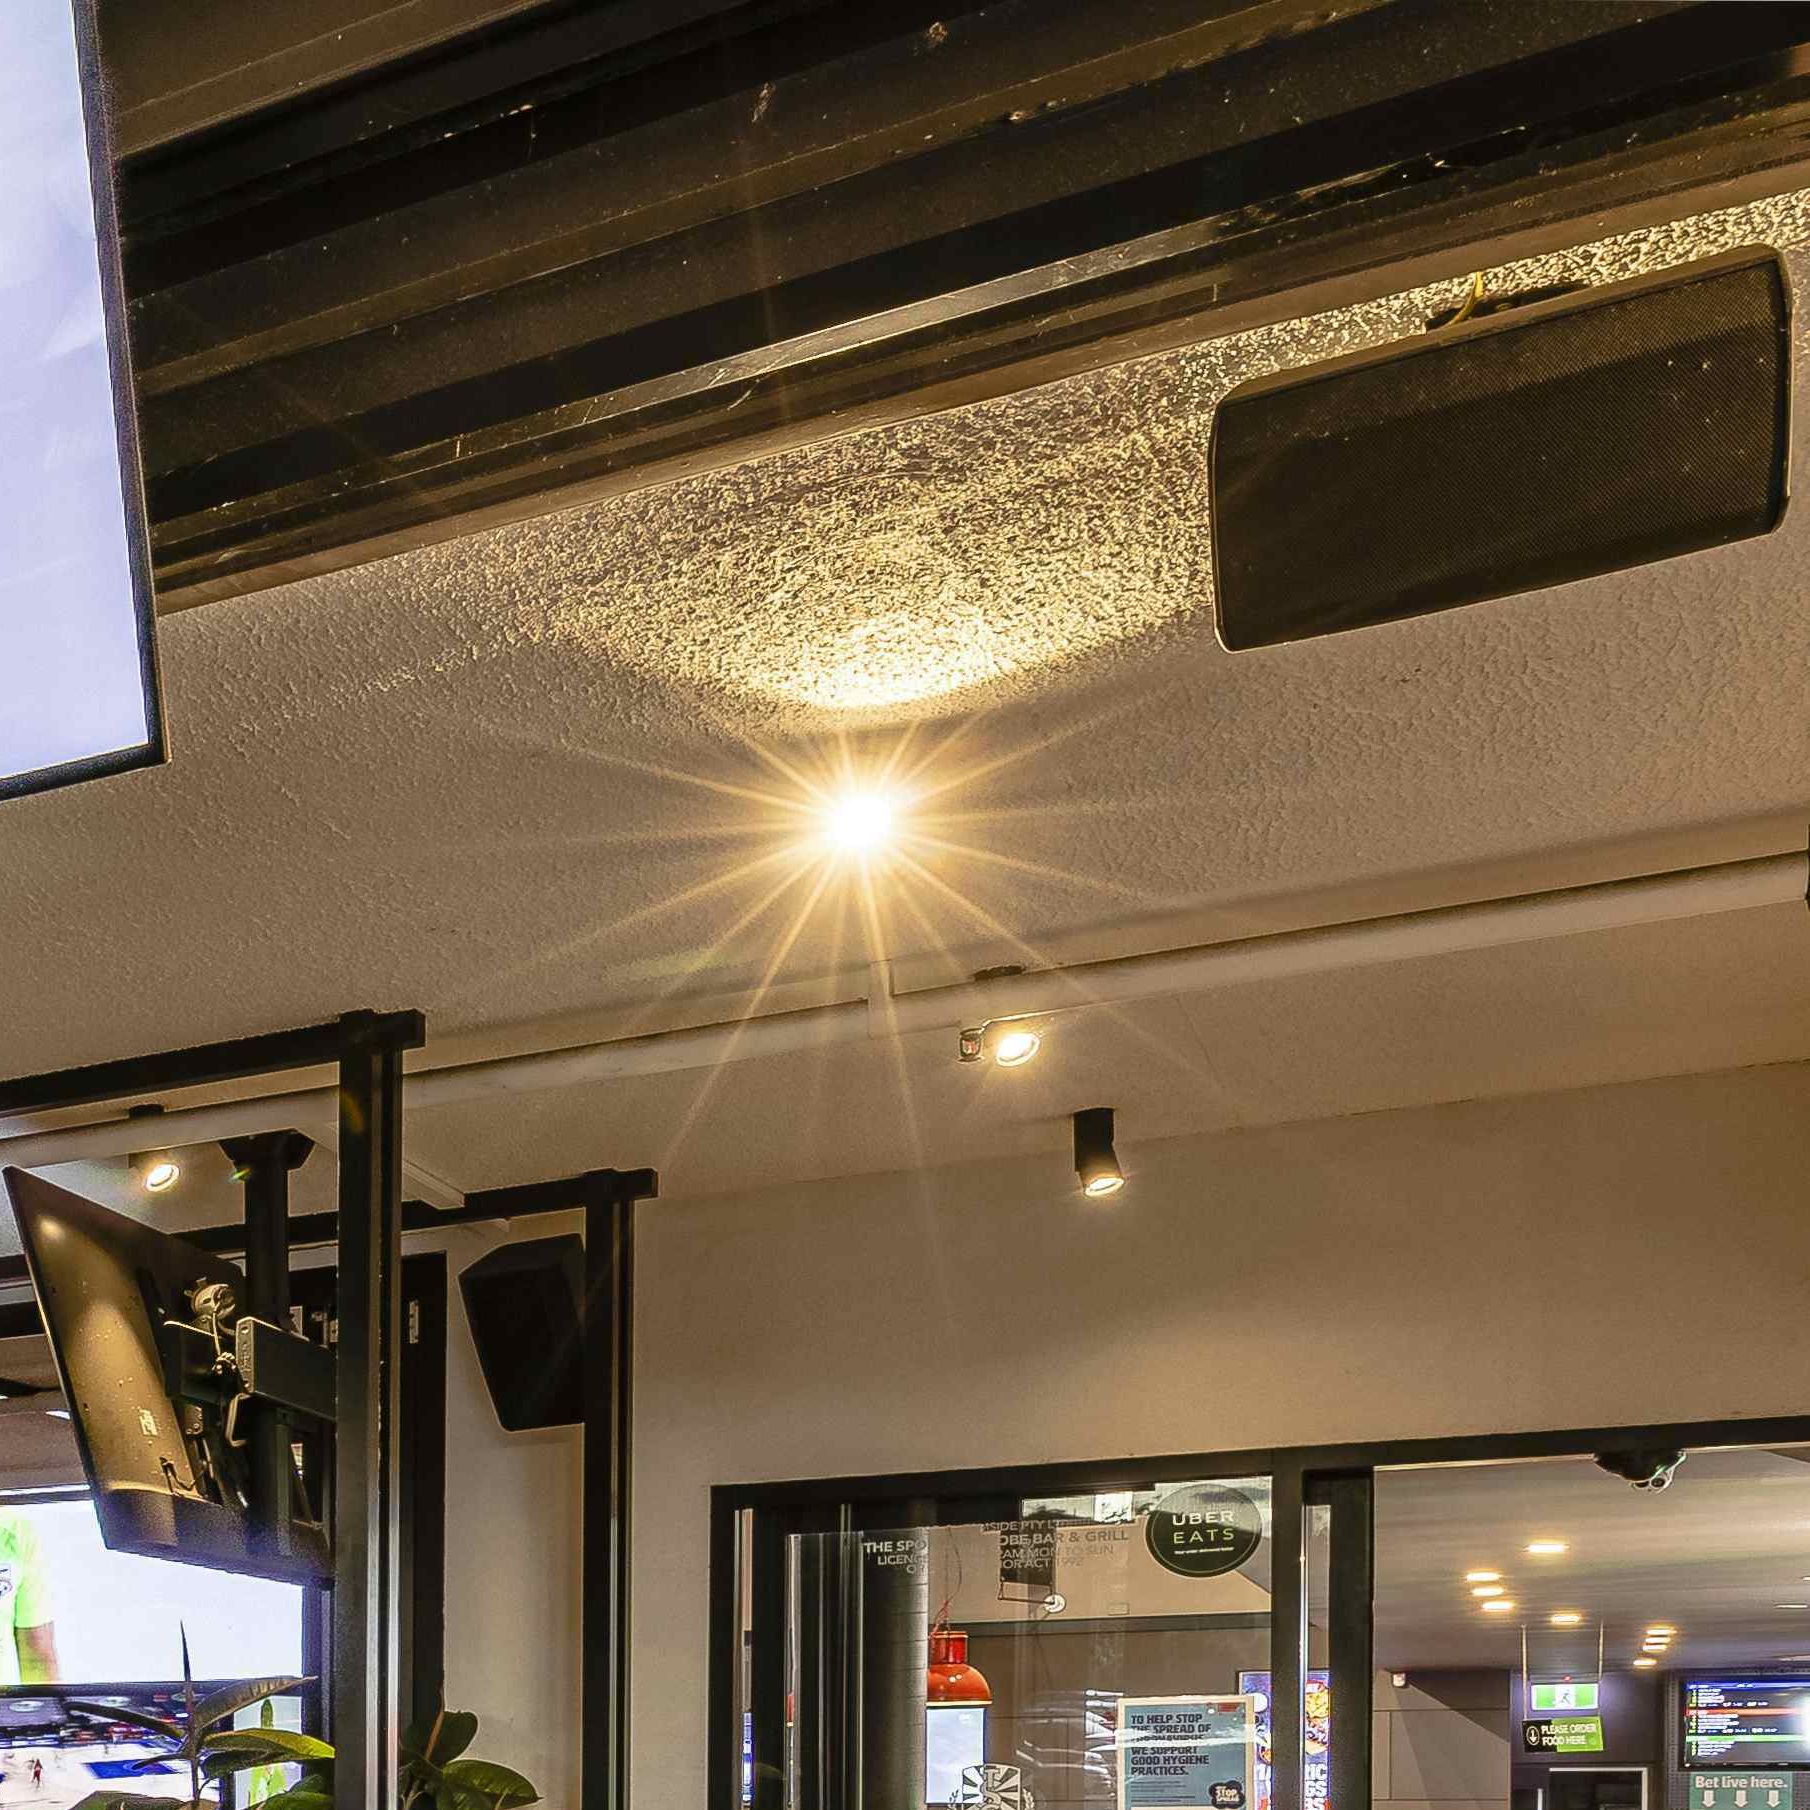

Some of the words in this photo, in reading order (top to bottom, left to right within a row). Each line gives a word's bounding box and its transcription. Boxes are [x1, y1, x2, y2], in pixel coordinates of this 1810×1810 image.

[1172, 1510, 1235, 1527] UBER
[1033, 1533, 1064, 1545] BAR
[1069, 1532, 1081, 1543] &
[1085, 1530, 1129, 1542] GRILL
[1172, 1527, 1236, 1545] EATS
[864, 1541, 893, 1553] THE
[1086, 1544, 1114, 1555] SUN
[1131, 1714, 1144, 1724] TO
[1146, 1714, 1173, 1724] HELP
[1176, 1713, 1203, 1724] STOP
[1154, 1724, 1195, 1734] SPREAD
[1198, 1724, 1211, 1733] OF
[1541, 1723, 1569, 1734] PLEASE
[1570, 1723, 1597, 1733] ORDER
[1542, 1735, 1565, 1746] FOOD
[1565, 1735, 1587, 1745] HERE
[1131, 1746, 1148, 1756] WE
[1150, 1746, 1198, 1756] SUPPORT
[1131, 1756, 1160, 1766] GOOD
[1163, 1755, 1210, 1765] HYGIENE
[1131, 1766, 1190, 1776] PRACTICES.
[1695, 1775, 1720, 1788] Bet
[1722, 1775, 1749, 1788] live
[1751, 1775, 1788, 1788] here.
